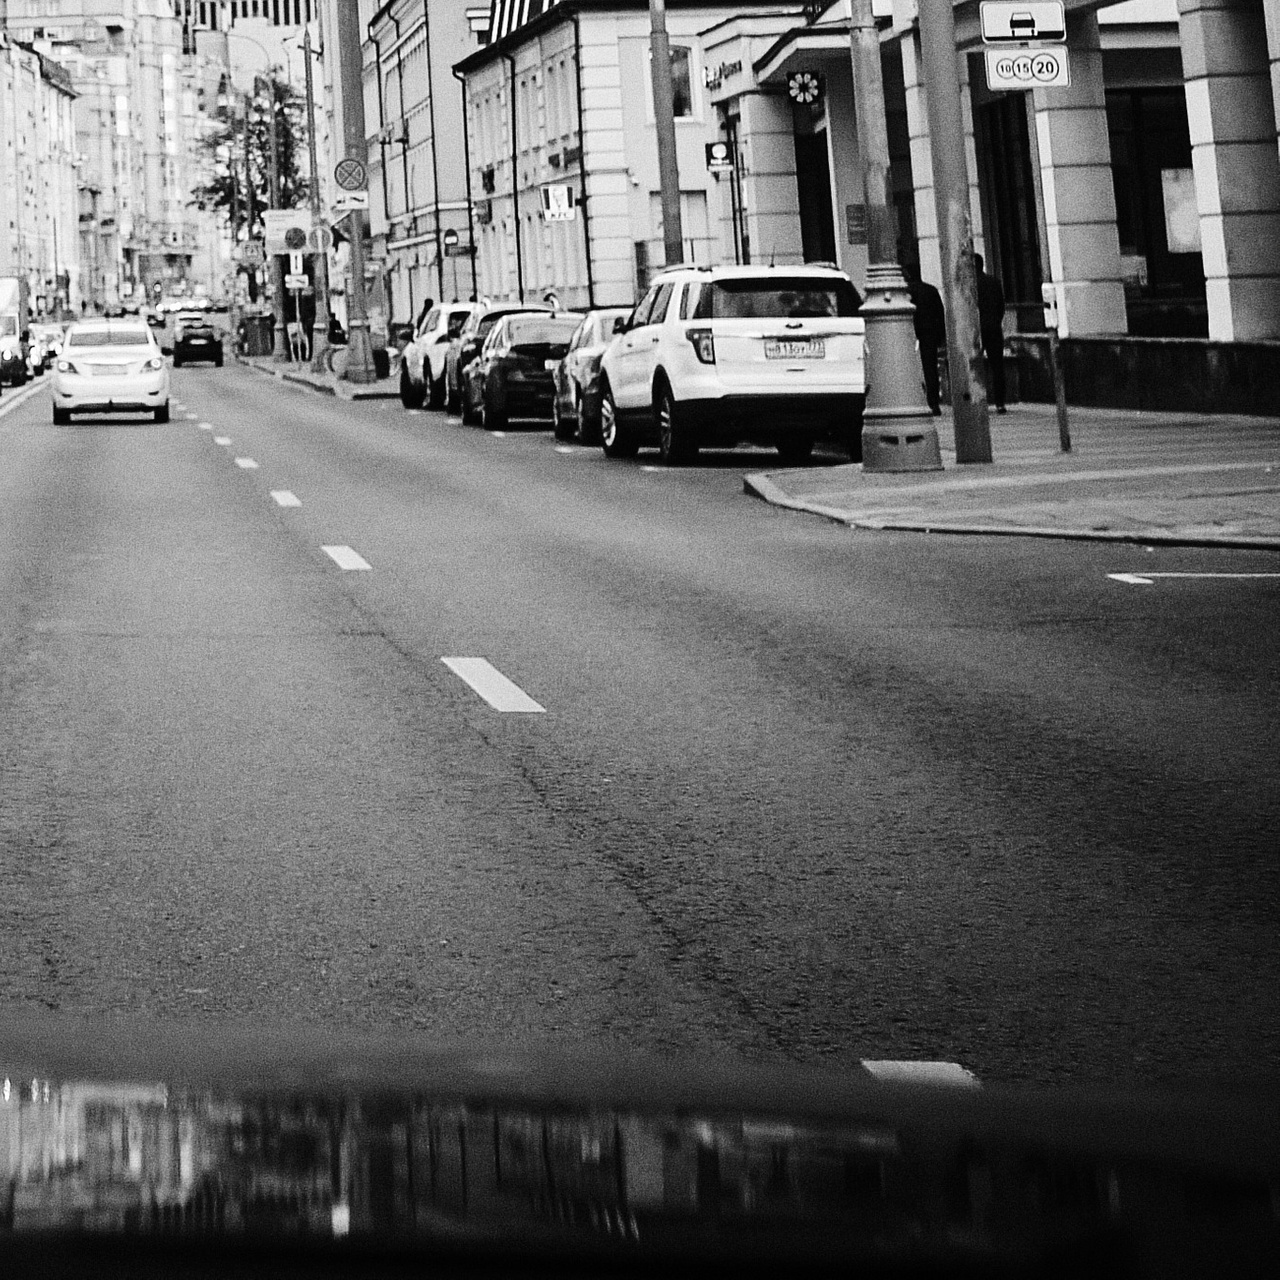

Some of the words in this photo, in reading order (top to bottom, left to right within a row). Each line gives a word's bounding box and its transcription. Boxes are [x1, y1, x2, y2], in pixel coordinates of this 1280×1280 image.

[1000, 64, 1012, 73] 10
[1016, 62, 1030, 74] 15
[1036, 61, 1055, 74] 20
